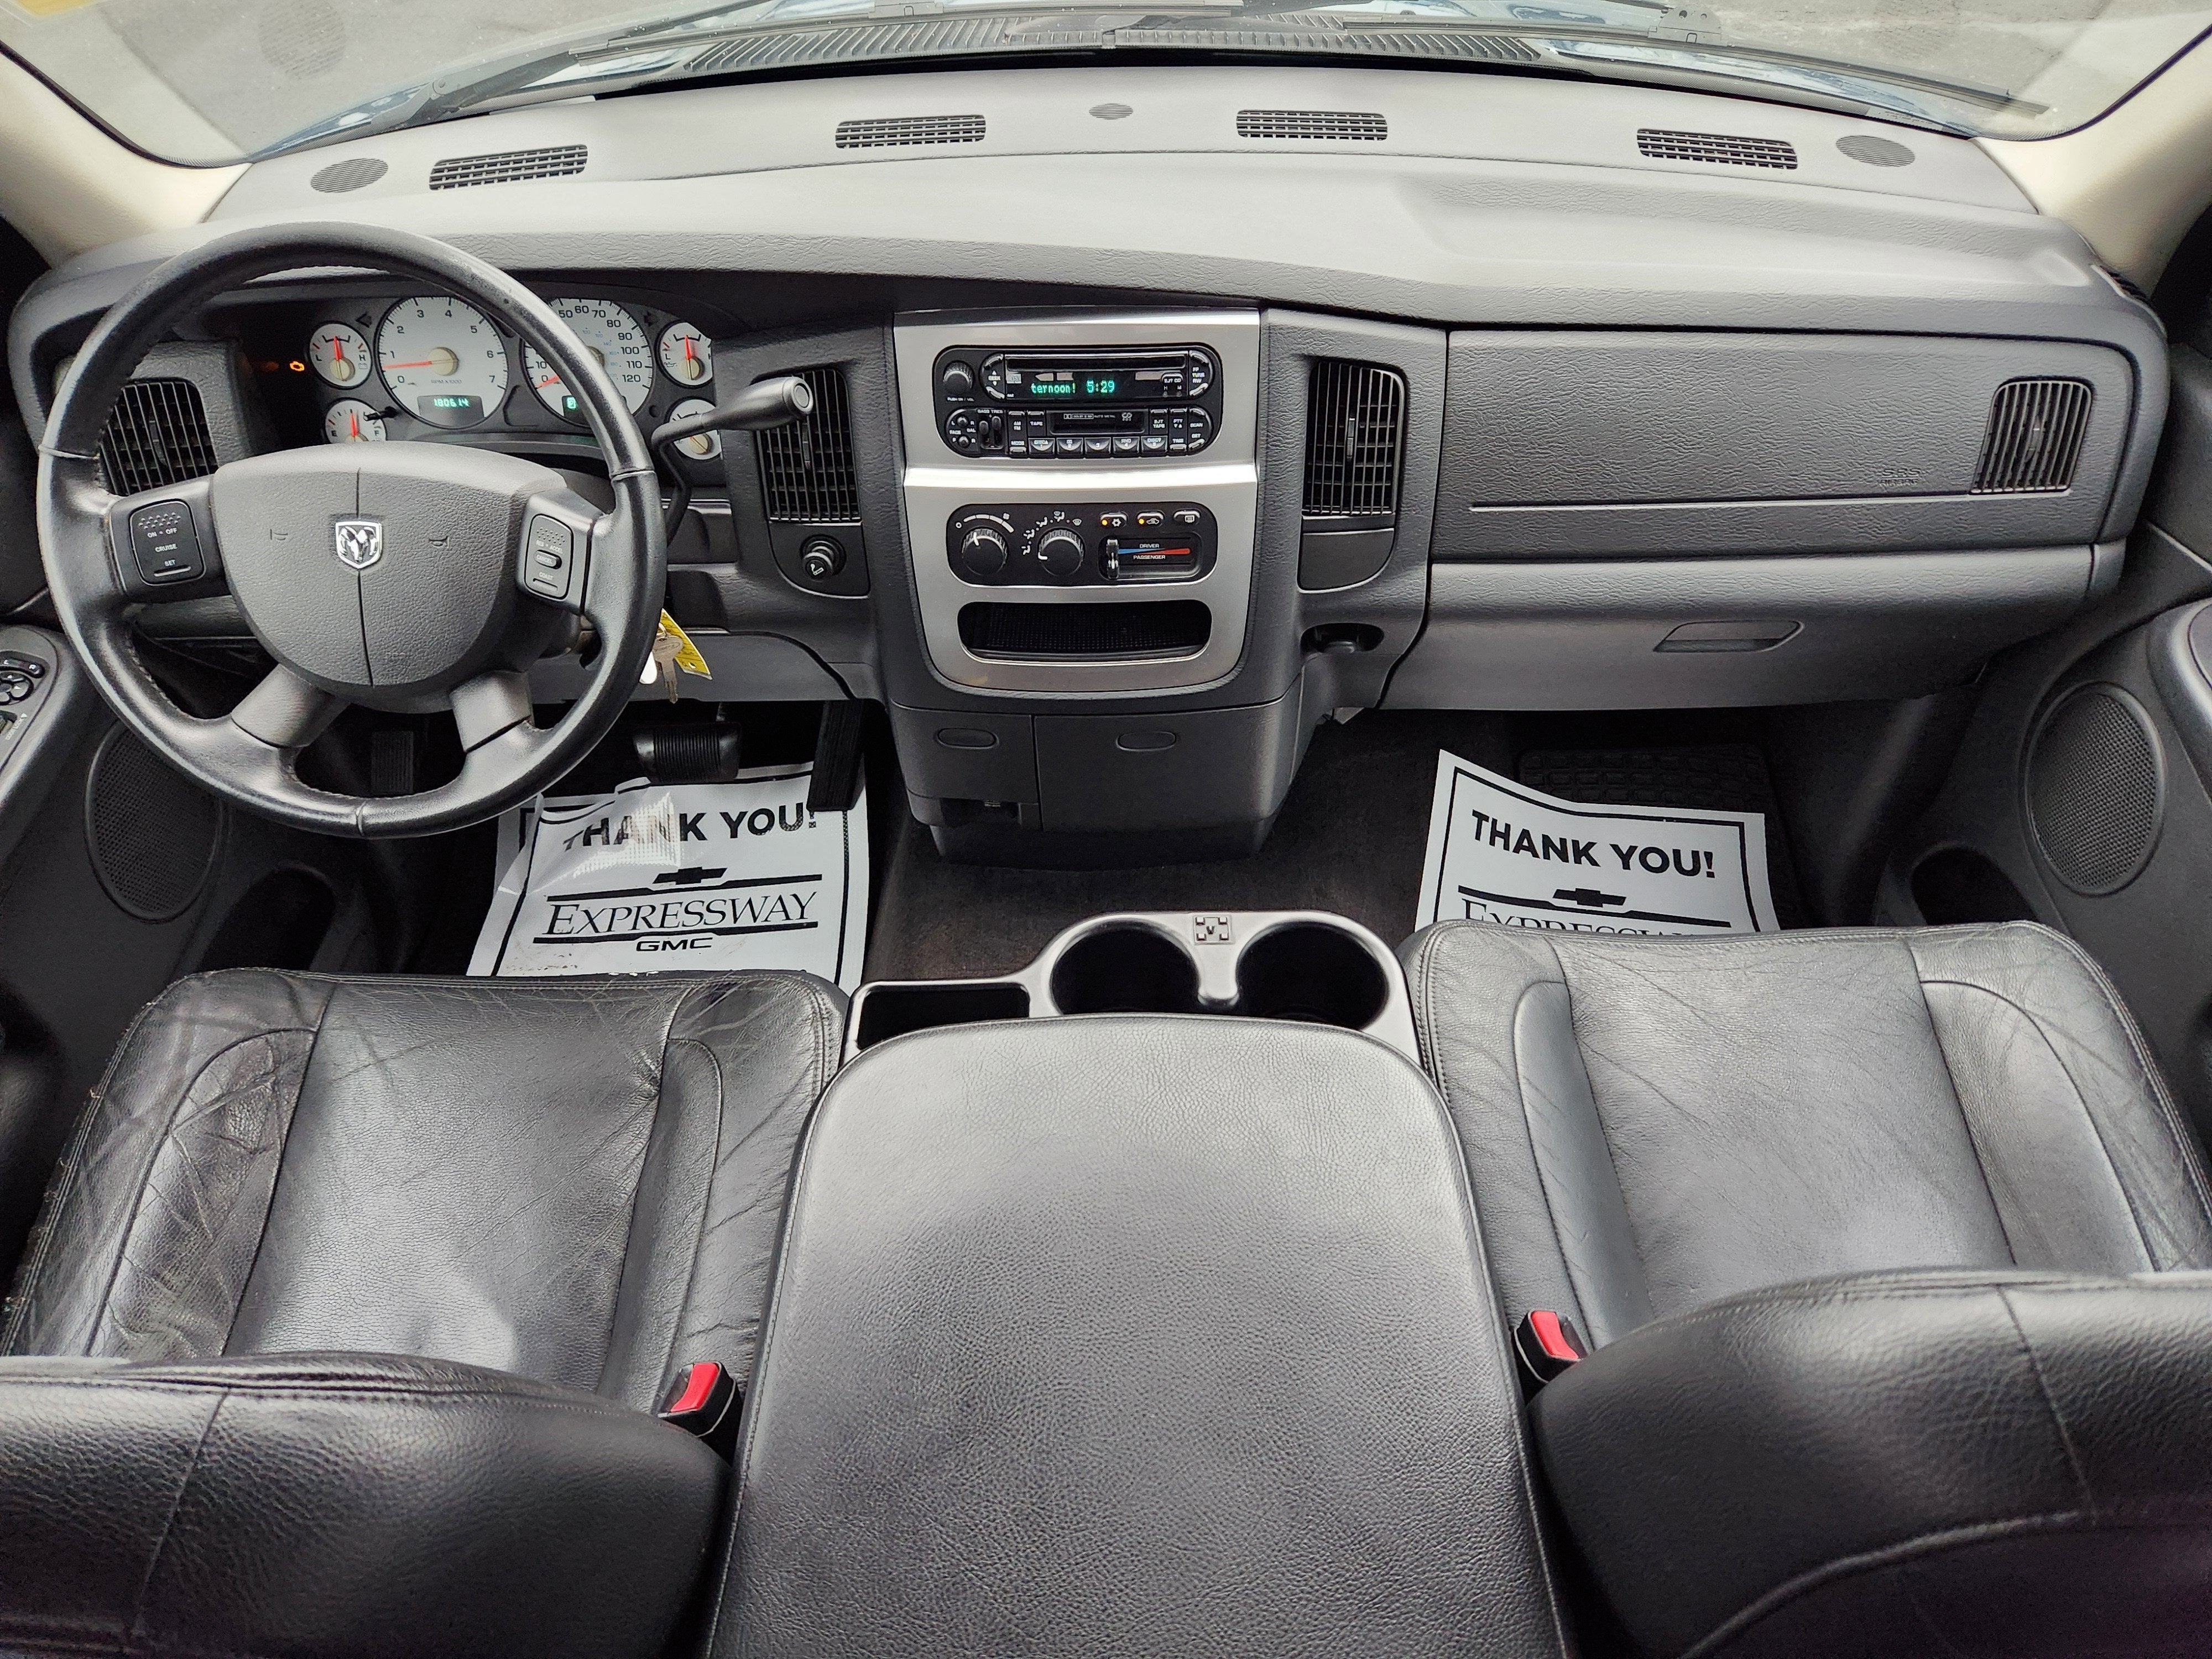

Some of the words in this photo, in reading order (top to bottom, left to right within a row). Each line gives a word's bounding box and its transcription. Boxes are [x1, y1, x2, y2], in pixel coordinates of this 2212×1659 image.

[417, 310, 424, 318] 3
[575, 305, 589, 314] 60
[397, 326, 404, 334] 2
[471, 325, 477, 333] 5
[1031, 383, 1076, 394] ternoon!
[1087, 380, 1115, 393] 5:29
[155, 544, 178, 552] CRUISE
[539, 572, 553, 580] COAST
[563, 812, 708, 852] THANK
[719, 802, 816, 839] YOU!
[1472, 809, 1601, 867] THANK
[1609, 843, 1715, 878] YOU!
[542, 891, 816, 935] EXPRESSWAY
[636, 937, 713, 952] GMC
